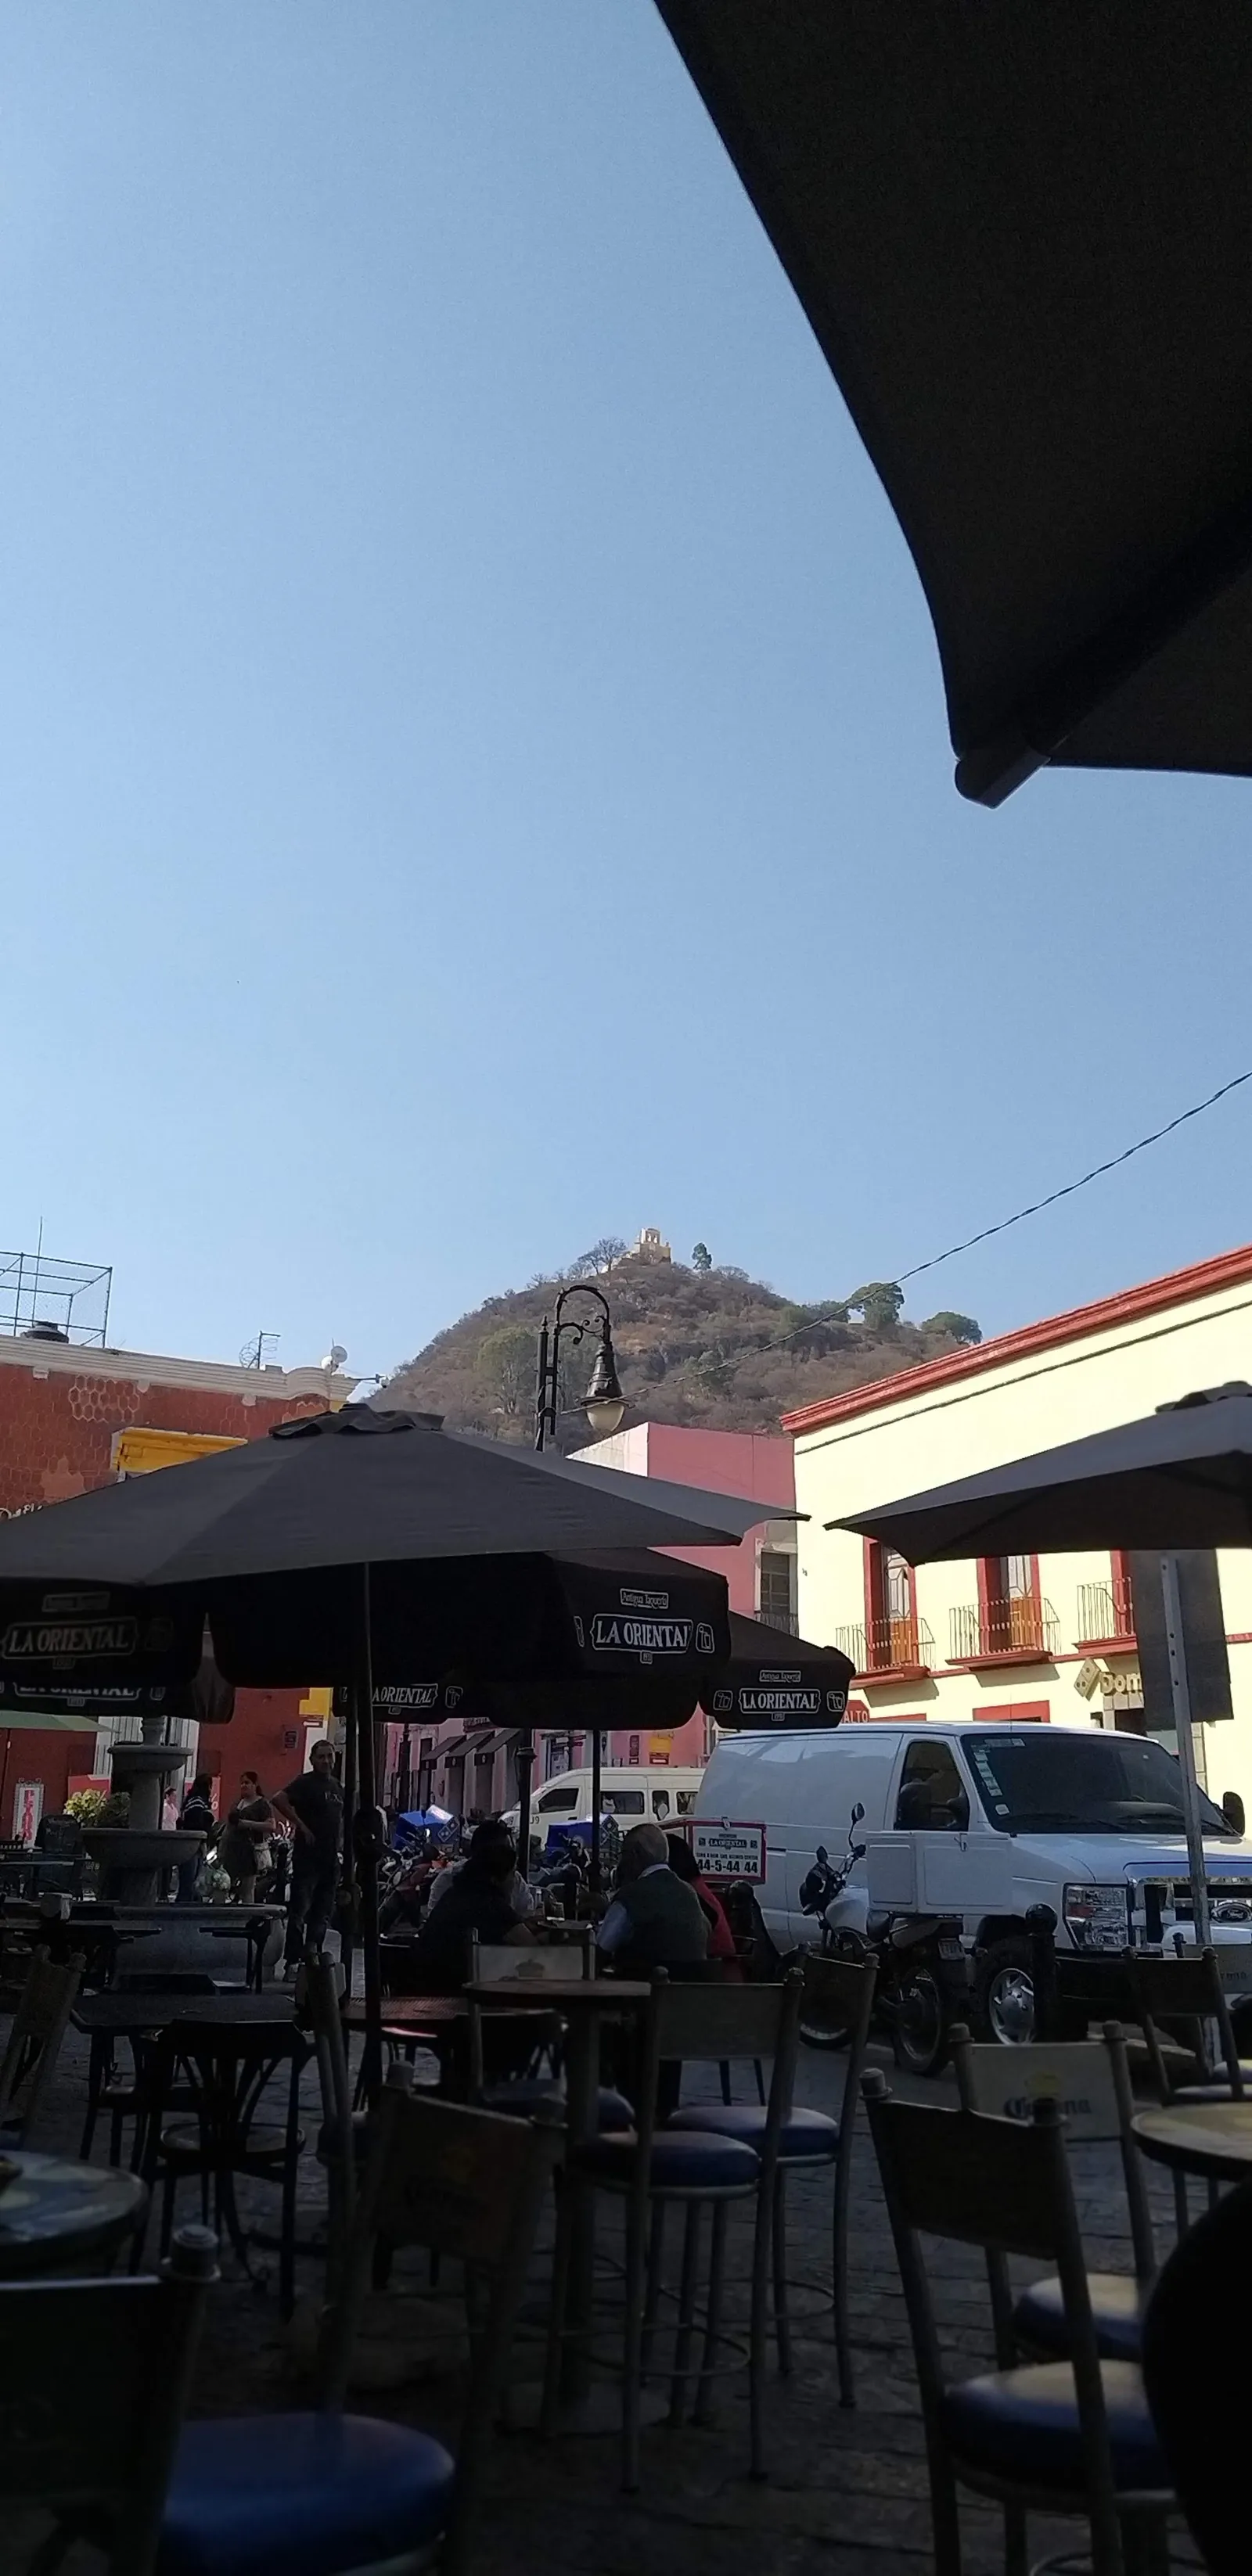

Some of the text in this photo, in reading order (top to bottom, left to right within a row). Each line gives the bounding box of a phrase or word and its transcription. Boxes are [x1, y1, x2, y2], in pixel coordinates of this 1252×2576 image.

[9, 1624, 130, 1653] LA ORIENTAL
[595, 1620, 621, 1644] LA
[380, 1687, 434, 1704] ORIENTAL
[743, 1693, 817, 1709] LA ORIENTAL
[844, 1710, 868, 1723] ALTO
[744, 1862, 758, 1873] 44
